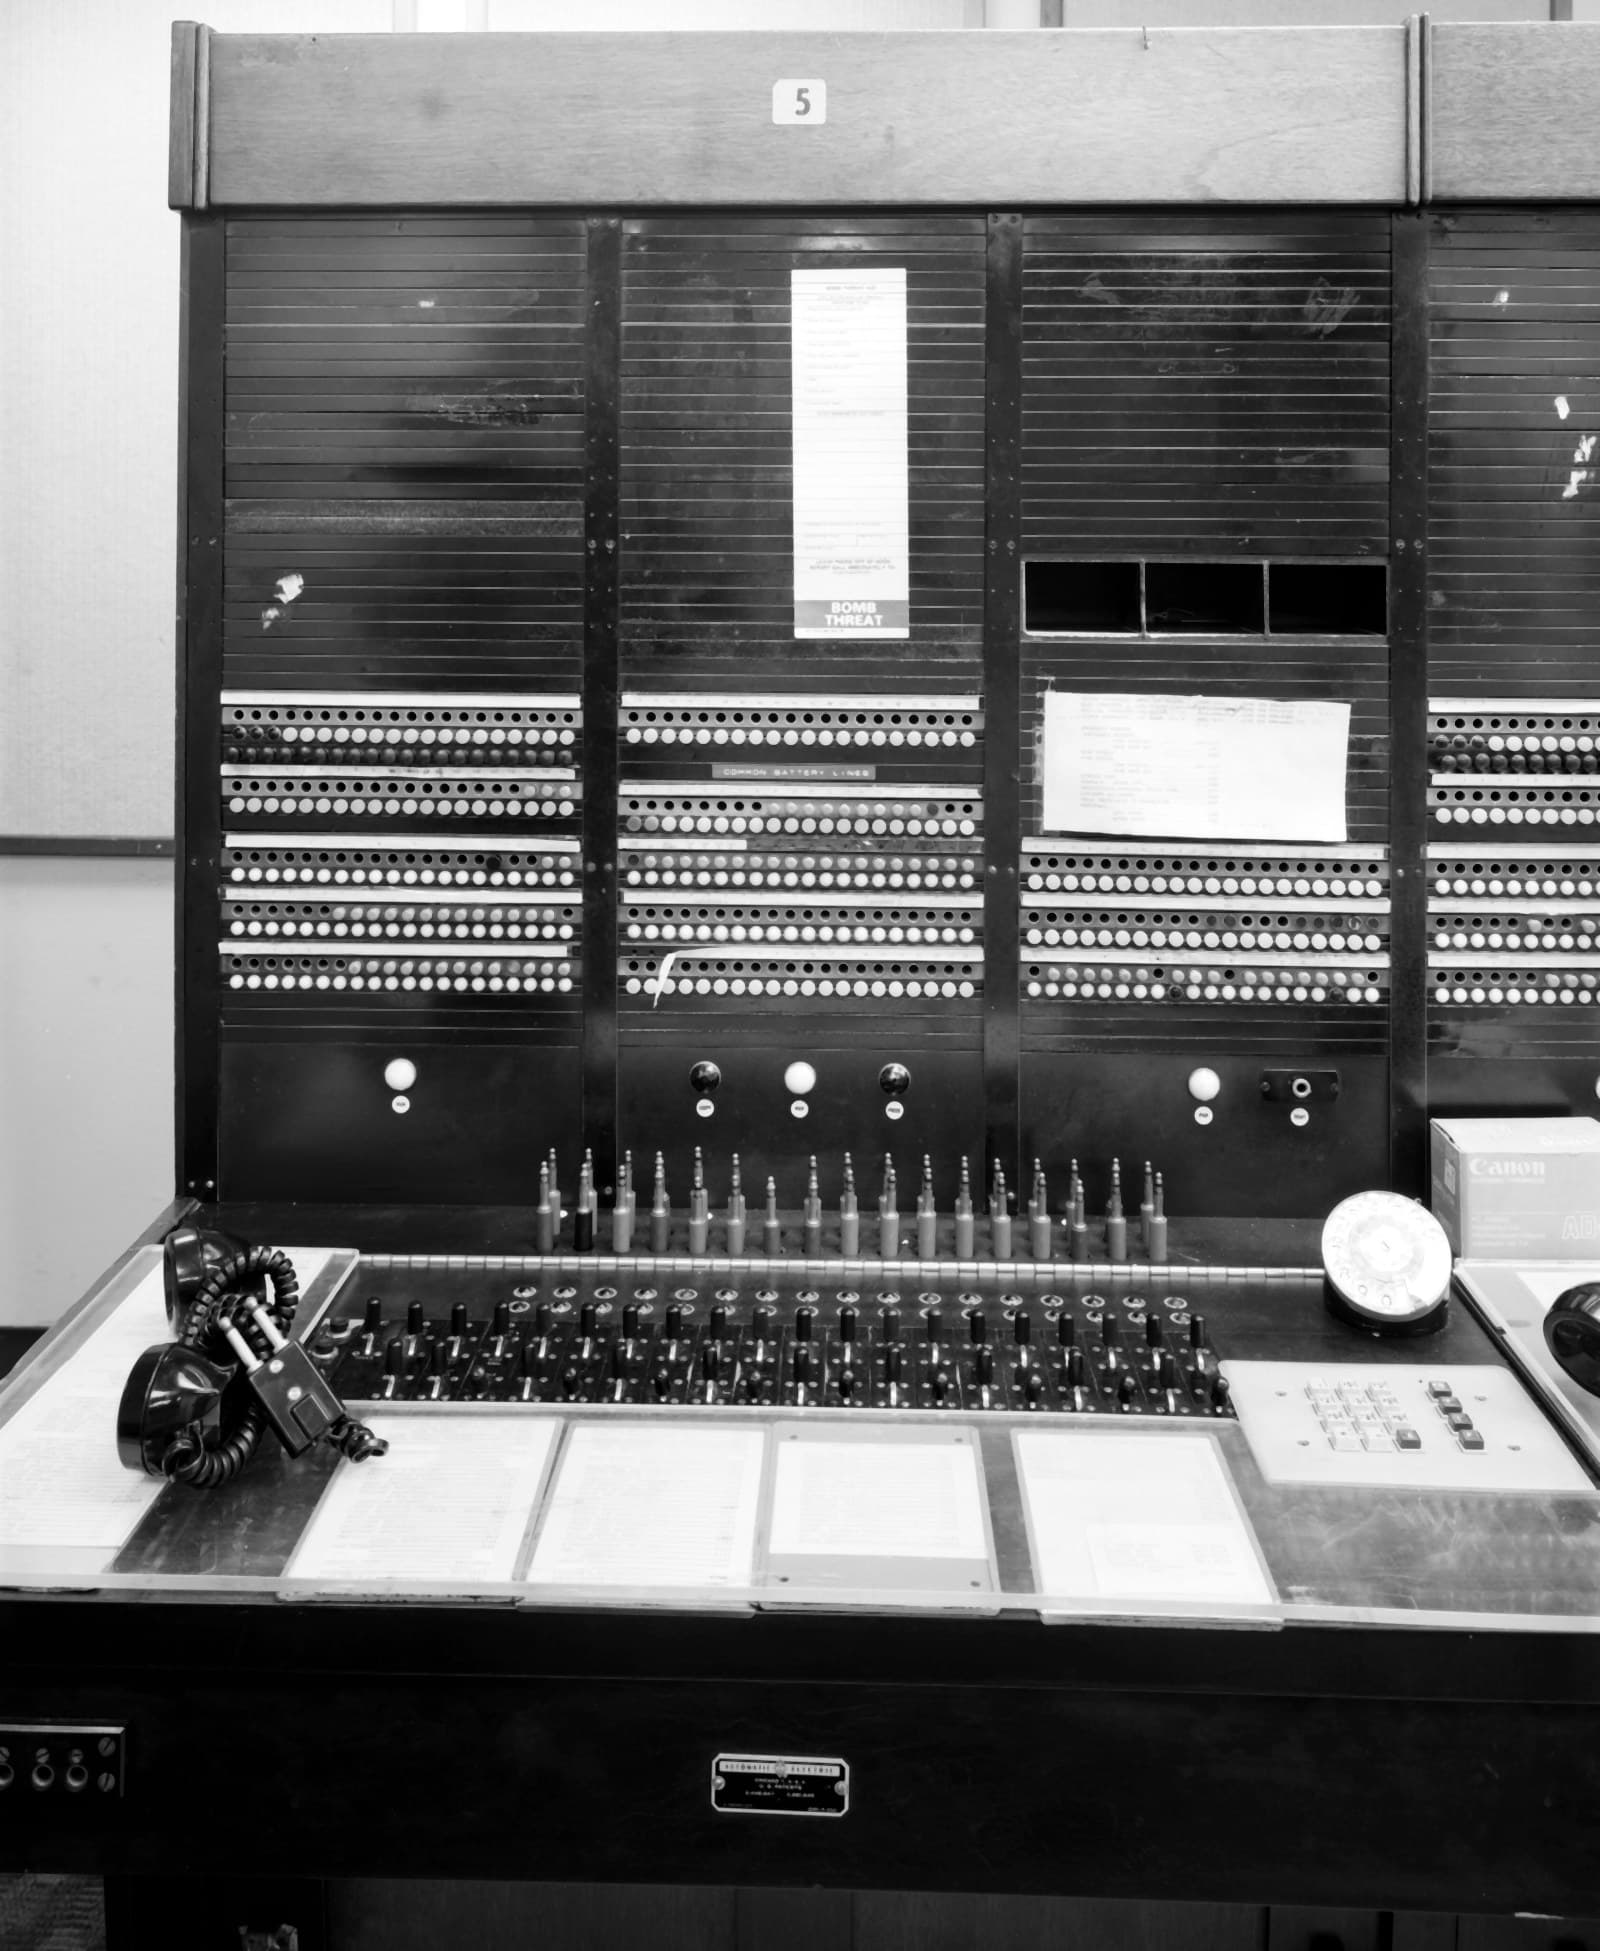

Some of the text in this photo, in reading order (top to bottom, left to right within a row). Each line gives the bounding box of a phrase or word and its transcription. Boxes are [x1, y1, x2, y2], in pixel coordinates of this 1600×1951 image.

[795, 87, 811, 116] 5
[831, 601, 877, 614] BOMB
[824, 614, 883, 627] THREAT
[723, 768, 767, 776] COMMON
[773, 769, 825, 777] BATTERY
[1469, 1158, 1545, 1176] Canon
